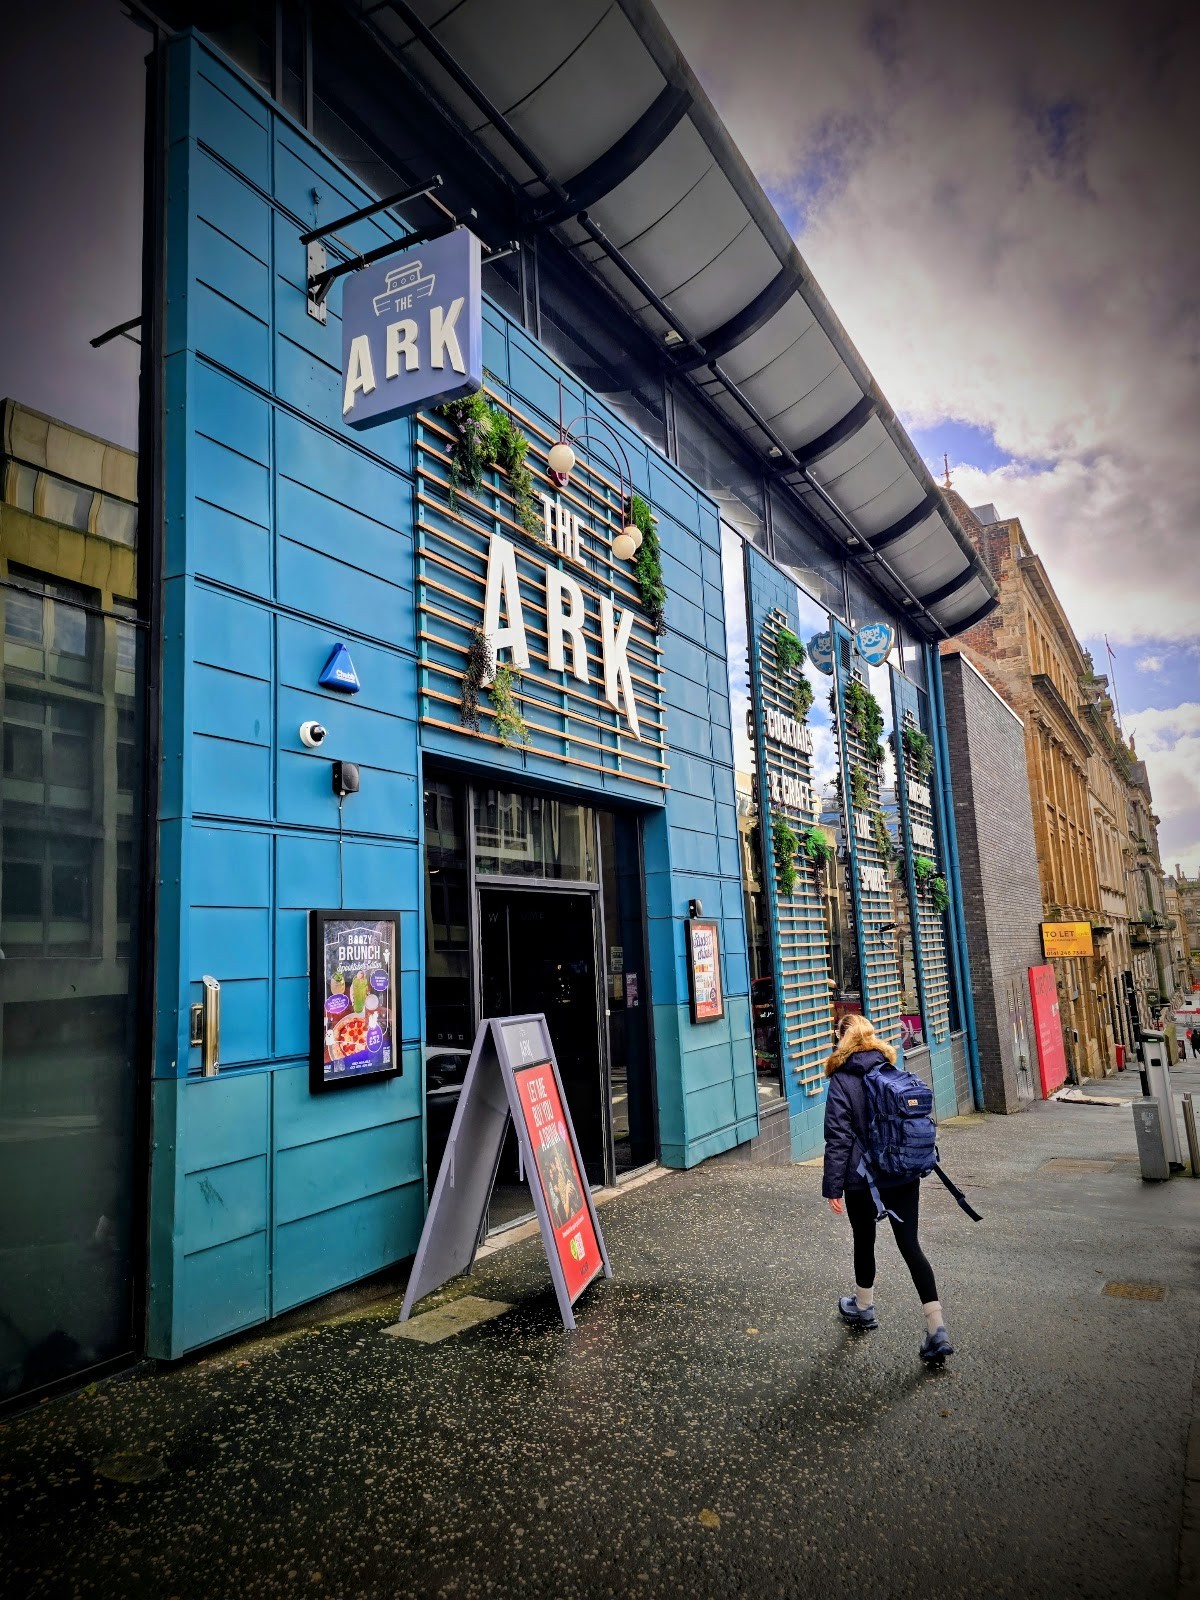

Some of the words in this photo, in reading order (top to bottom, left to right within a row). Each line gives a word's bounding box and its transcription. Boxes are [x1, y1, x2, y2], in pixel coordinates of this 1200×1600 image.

[394, 294, 413, 313] THE
[342, 296, 467, 416] ARK
[539, 492, 587, 568] THE
[480, 533, 642, 742] ARK
[766, 707, 813, 756] COCKTAILS
[770, 770, 781, 803] &
[781, 775, 811, 811] CRAFT
[338, 945, 381, 961] BRUNCH
[348, 934, 373, 945] BOOZY
[1059, 930, 1075, 938] LET
